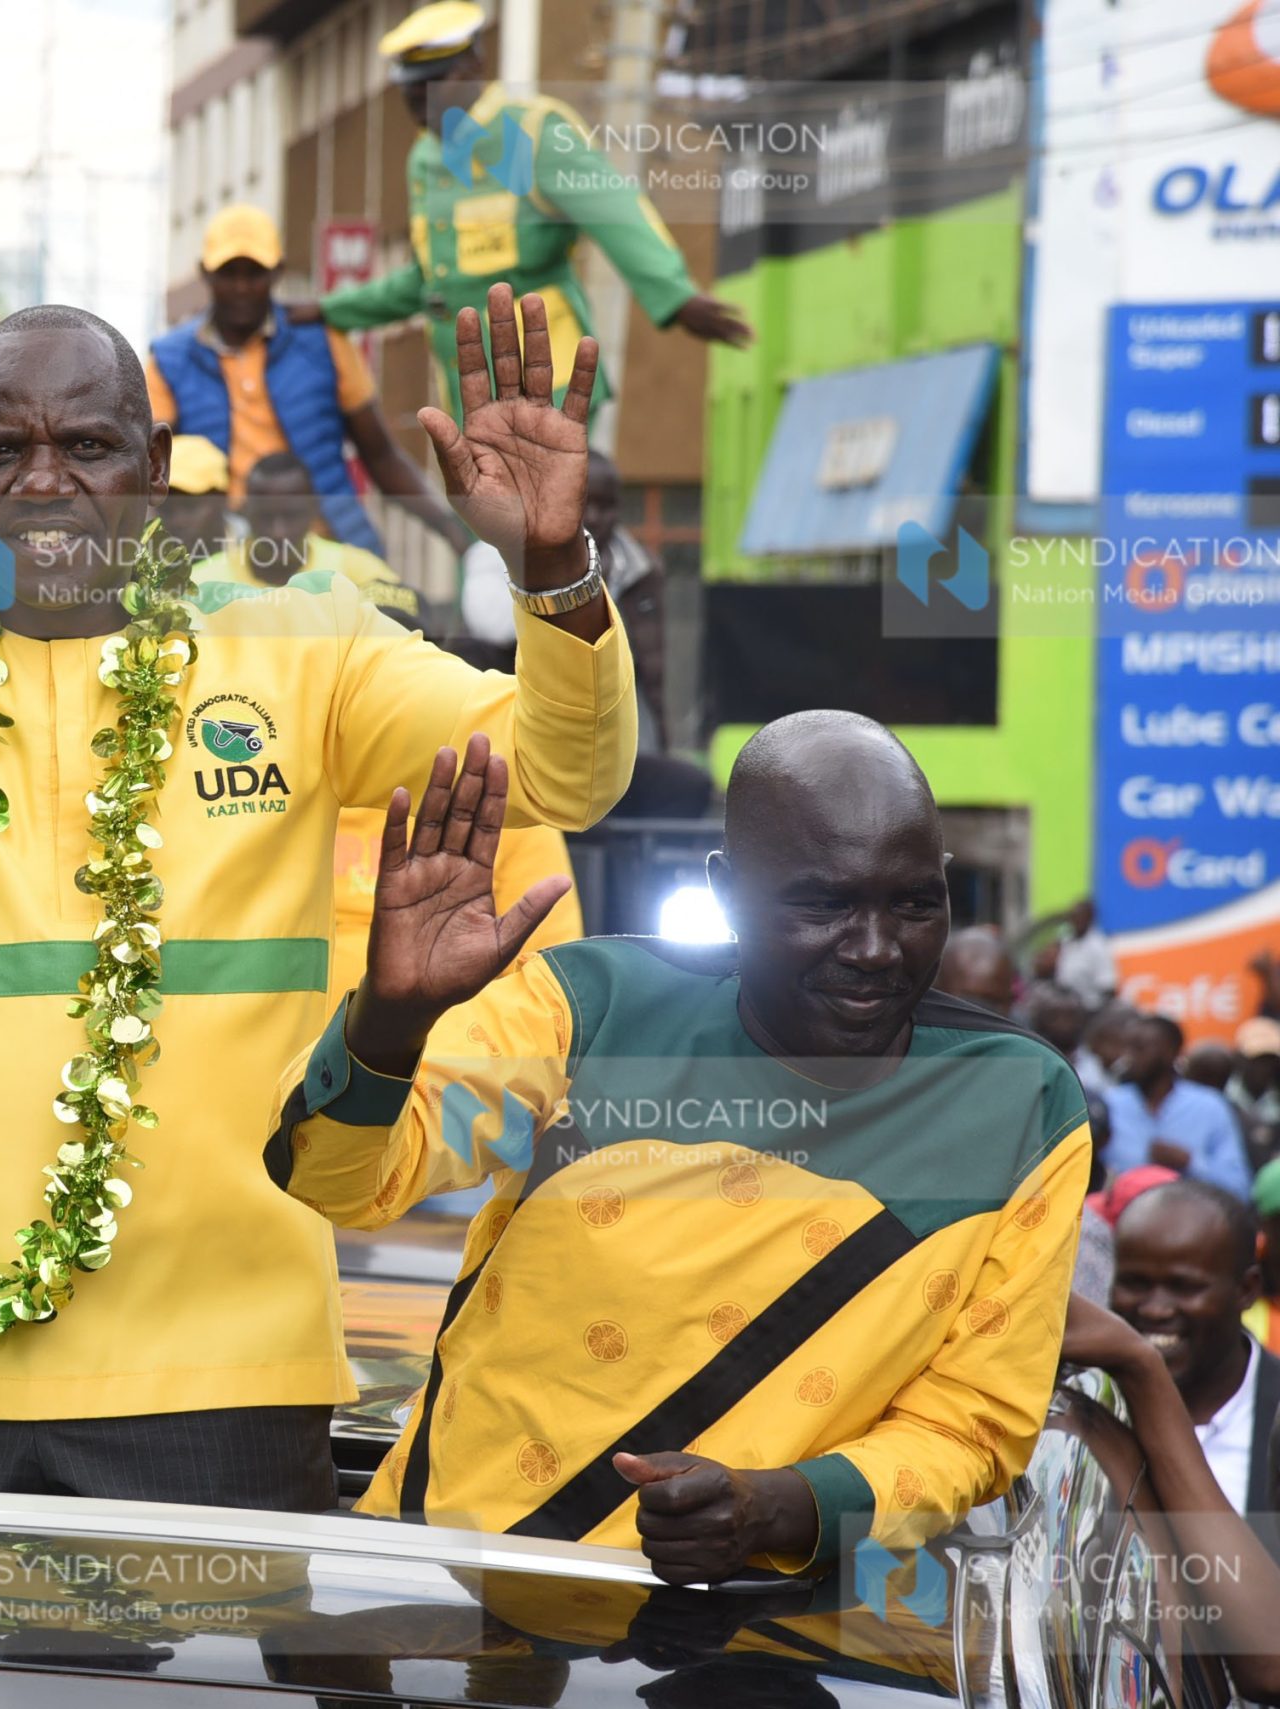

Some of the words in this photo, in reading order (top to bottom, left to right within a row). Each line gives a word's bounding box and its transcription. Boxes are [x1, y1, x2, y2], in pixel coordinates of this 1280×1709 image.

[186, 718, 198, 748] UNITED
[192, 693, 248, 718] DEMOCRATIC
[248, 701, 277, 740] ALLIANCE
[194, 763, 291, 801] UDA
[206, 803, 239, 818] KAZI
[242, 801, 256, 813] NI
[260, 799, 286, 813] KAZI
